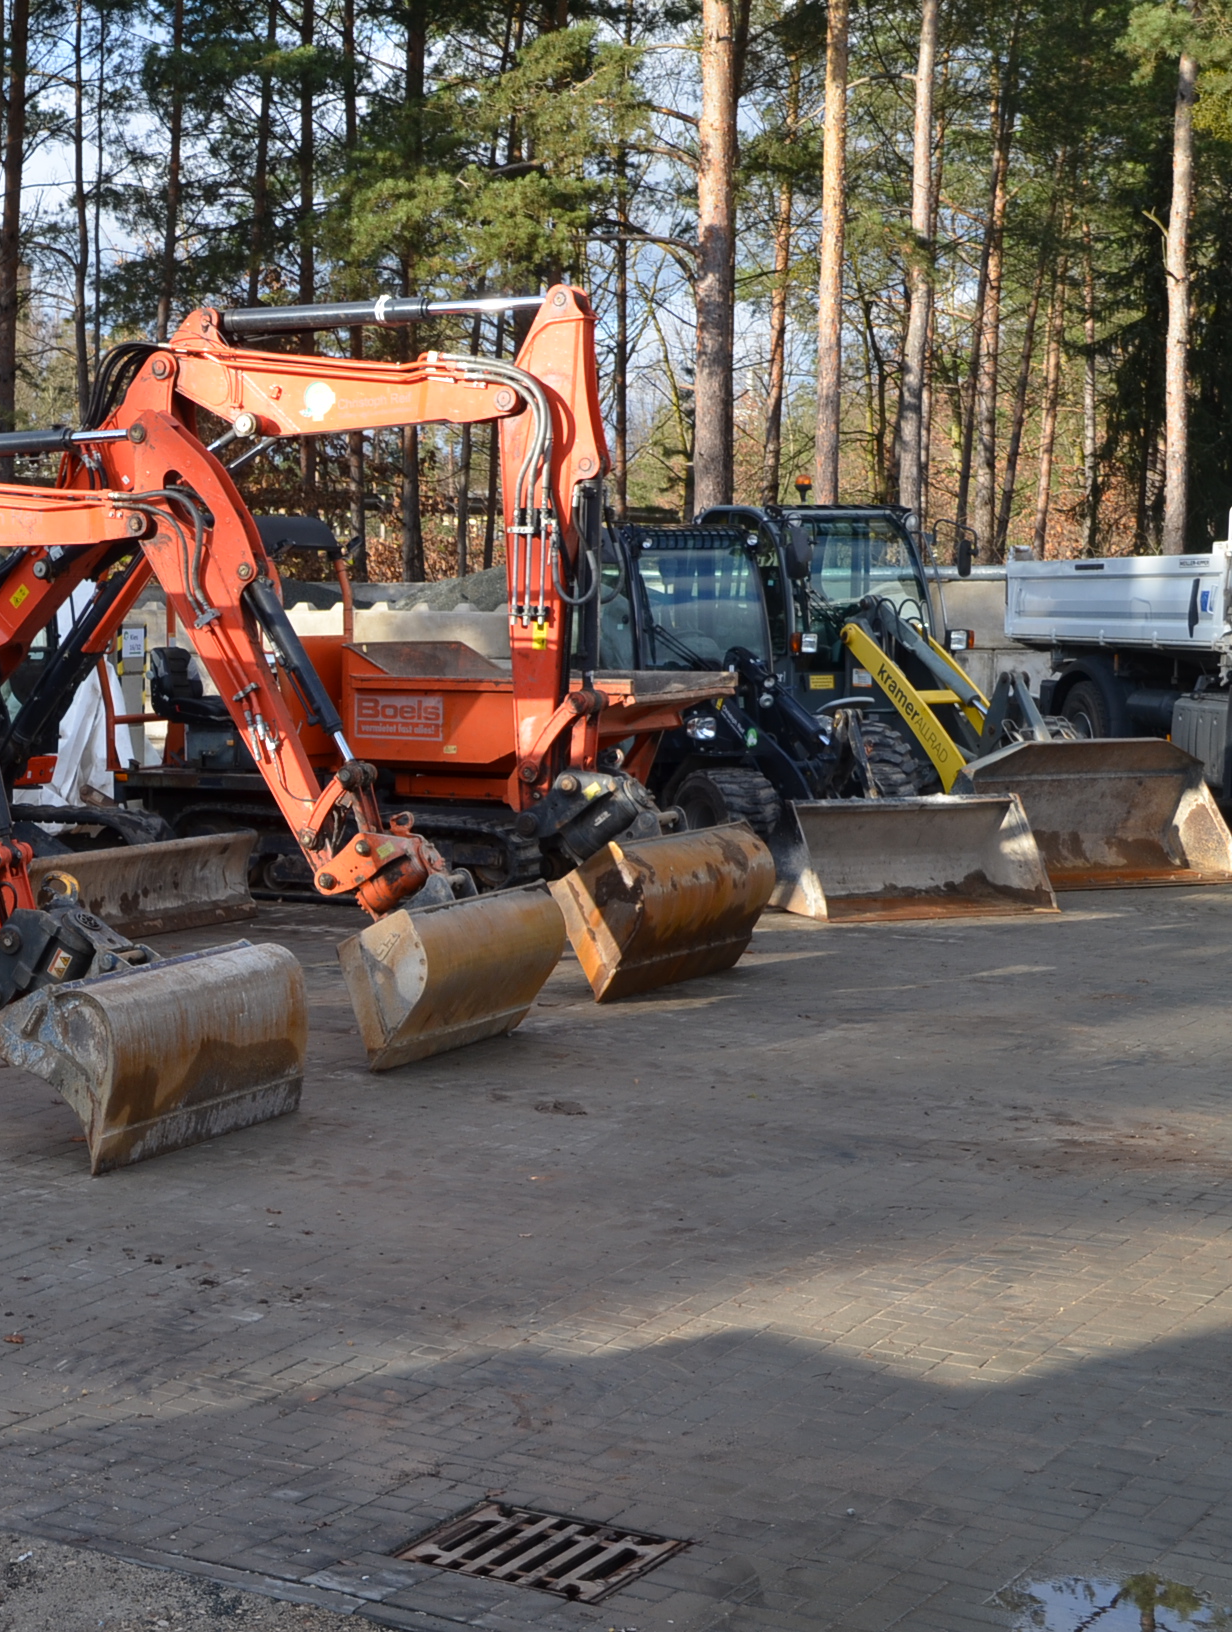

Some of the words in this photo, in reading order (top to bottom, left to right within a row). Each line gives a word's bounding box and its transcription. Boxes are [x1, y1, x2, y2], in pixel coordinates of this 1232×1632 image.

[357, 697, 441, 721] Boels
[877, 663, 920, 721] kramer
[915, 717, 949, 763] ALLRAD
[361, 723, 396, 733] vermietet
[398, 723, 412, 734] fast
[414, 724, 435, 735] alles!
